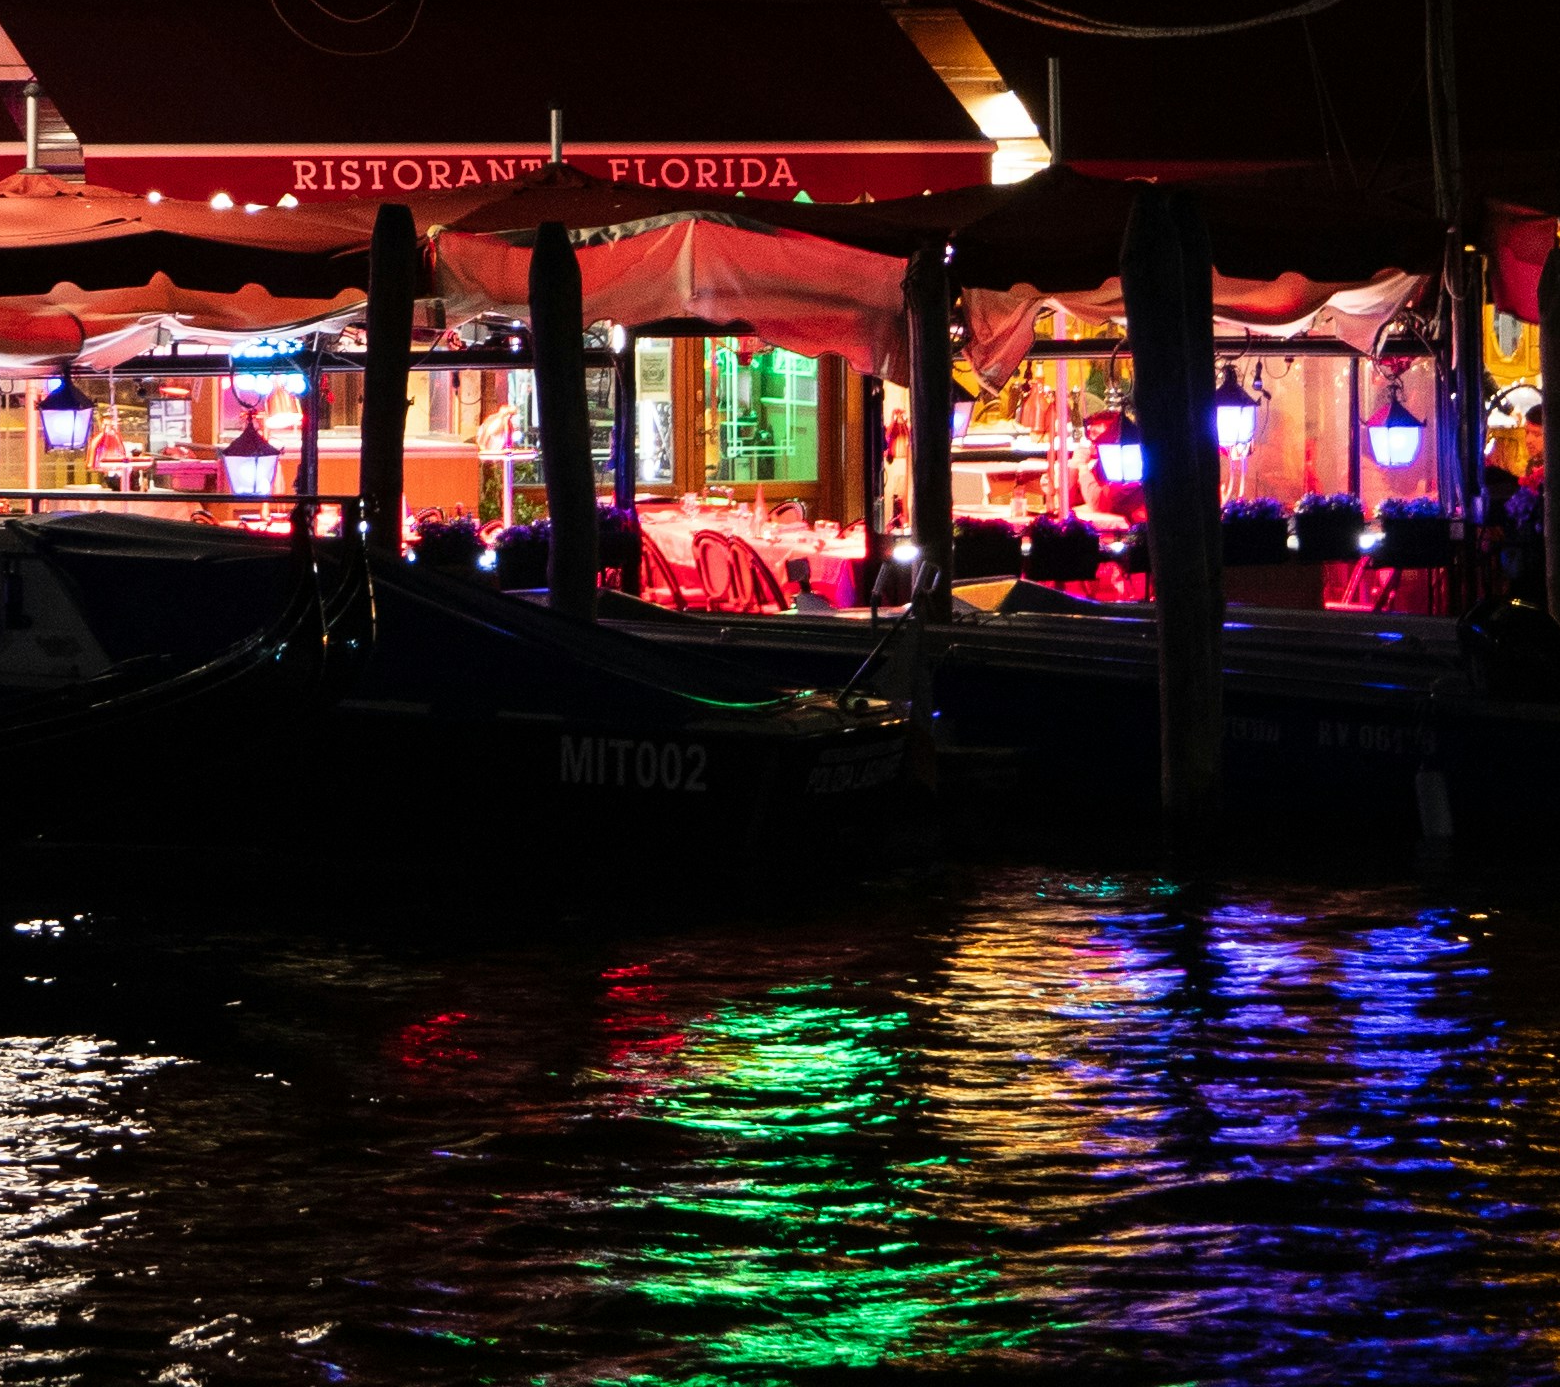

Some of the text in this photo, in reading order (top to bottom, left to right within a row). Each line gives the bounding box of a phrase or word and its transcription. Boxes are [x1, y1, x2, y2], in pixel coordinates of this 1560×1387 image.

[292, 157, 800, 192] RISTORAN FLORIDA
[559, 733, 709, 792] MIT002
